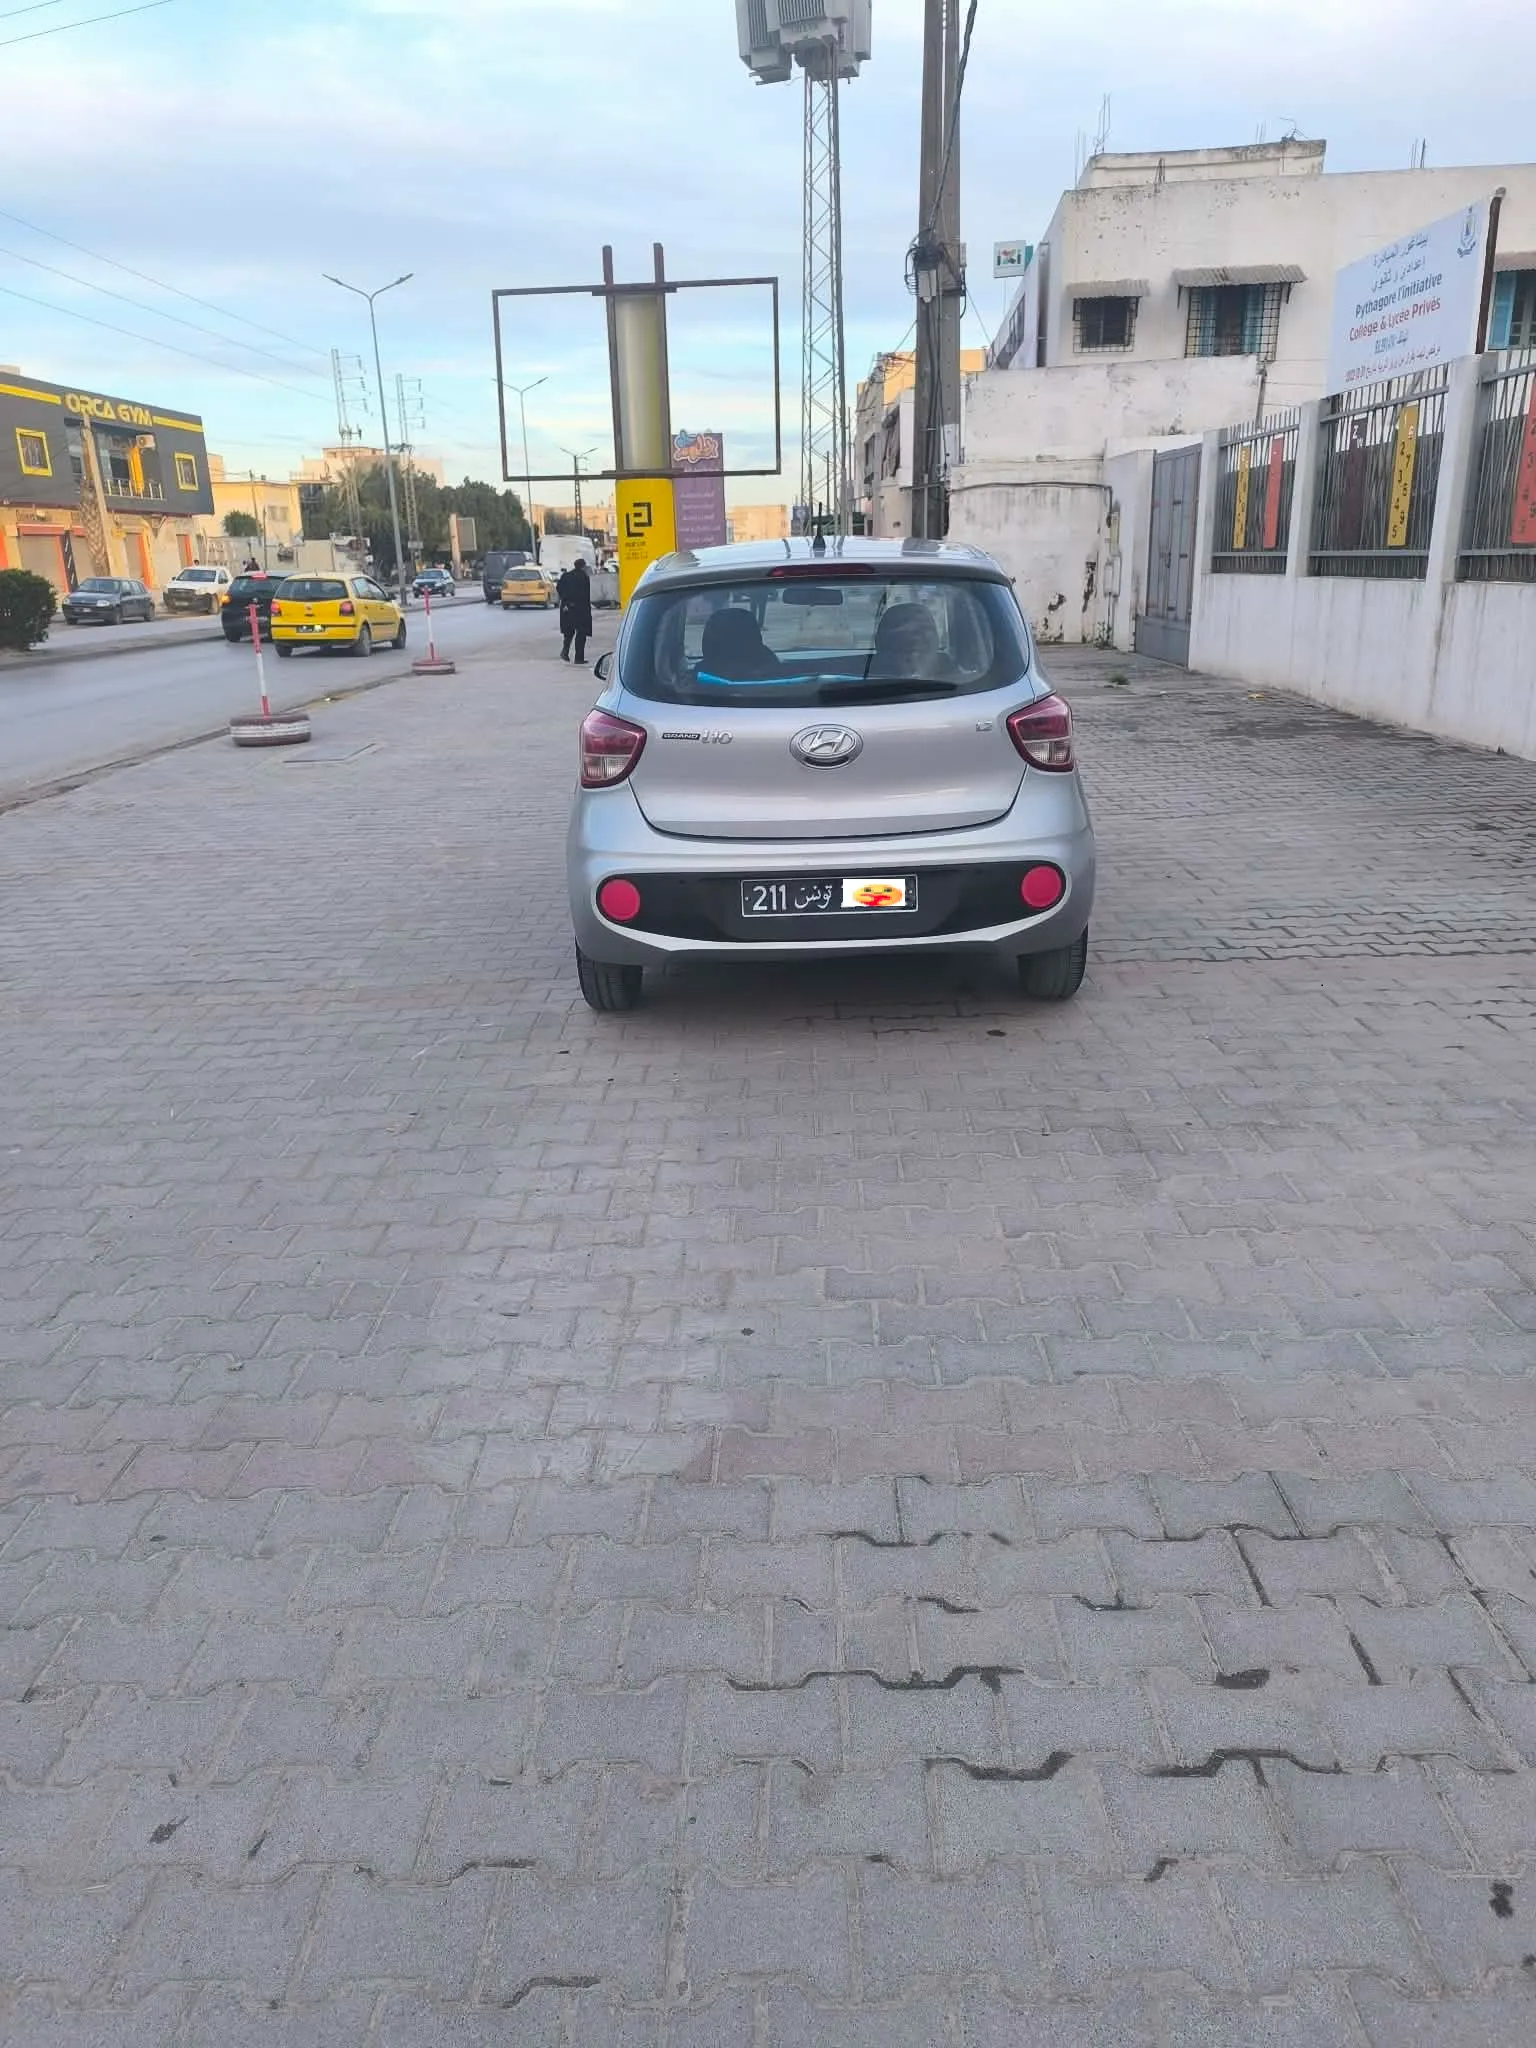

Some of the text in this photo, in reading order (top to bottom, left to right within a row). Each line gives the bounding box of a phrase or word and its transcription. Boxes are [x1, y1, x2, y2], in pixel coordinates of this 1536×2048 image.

[1355, 273, 1443, 319] Pythagore l'initiative
[1380, 315, 1386, 330] &
[1411, 296, 1441, 319] Privés
[64, 392, 153, 428] ORCA GYM
[663, 732, 701, 741] GRAND
[752, 883, 787, 911] 211
[794, 884, 833, 909] تونس
